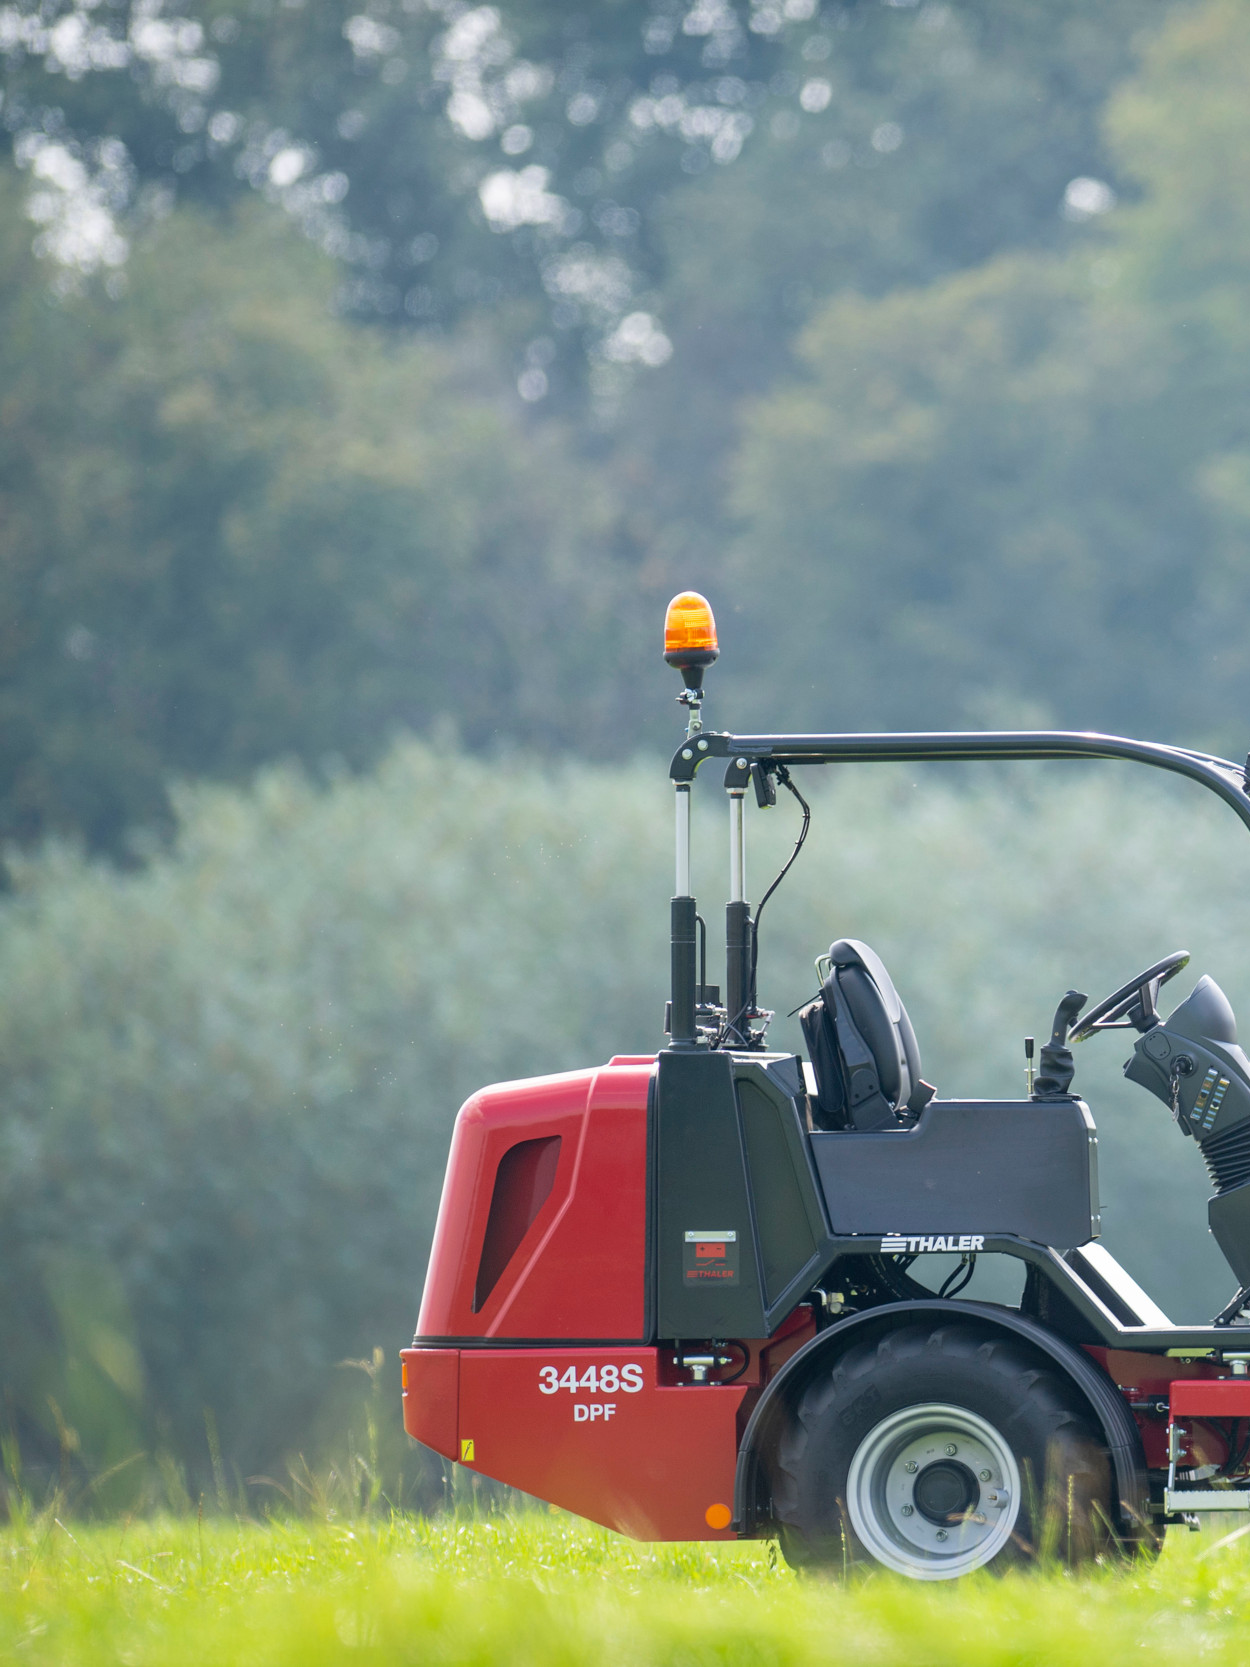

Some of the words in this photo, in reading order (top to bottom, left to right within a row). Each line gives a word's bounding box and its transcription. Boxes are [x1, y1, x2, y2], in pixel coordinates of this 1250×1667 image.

[906, 1235, 985, 1253] THALER
[698, 1269, 735, 1279] THALER
[538, 1363, 644, 1395] 3448S
[573, 1403, 617, 1422] DPF
